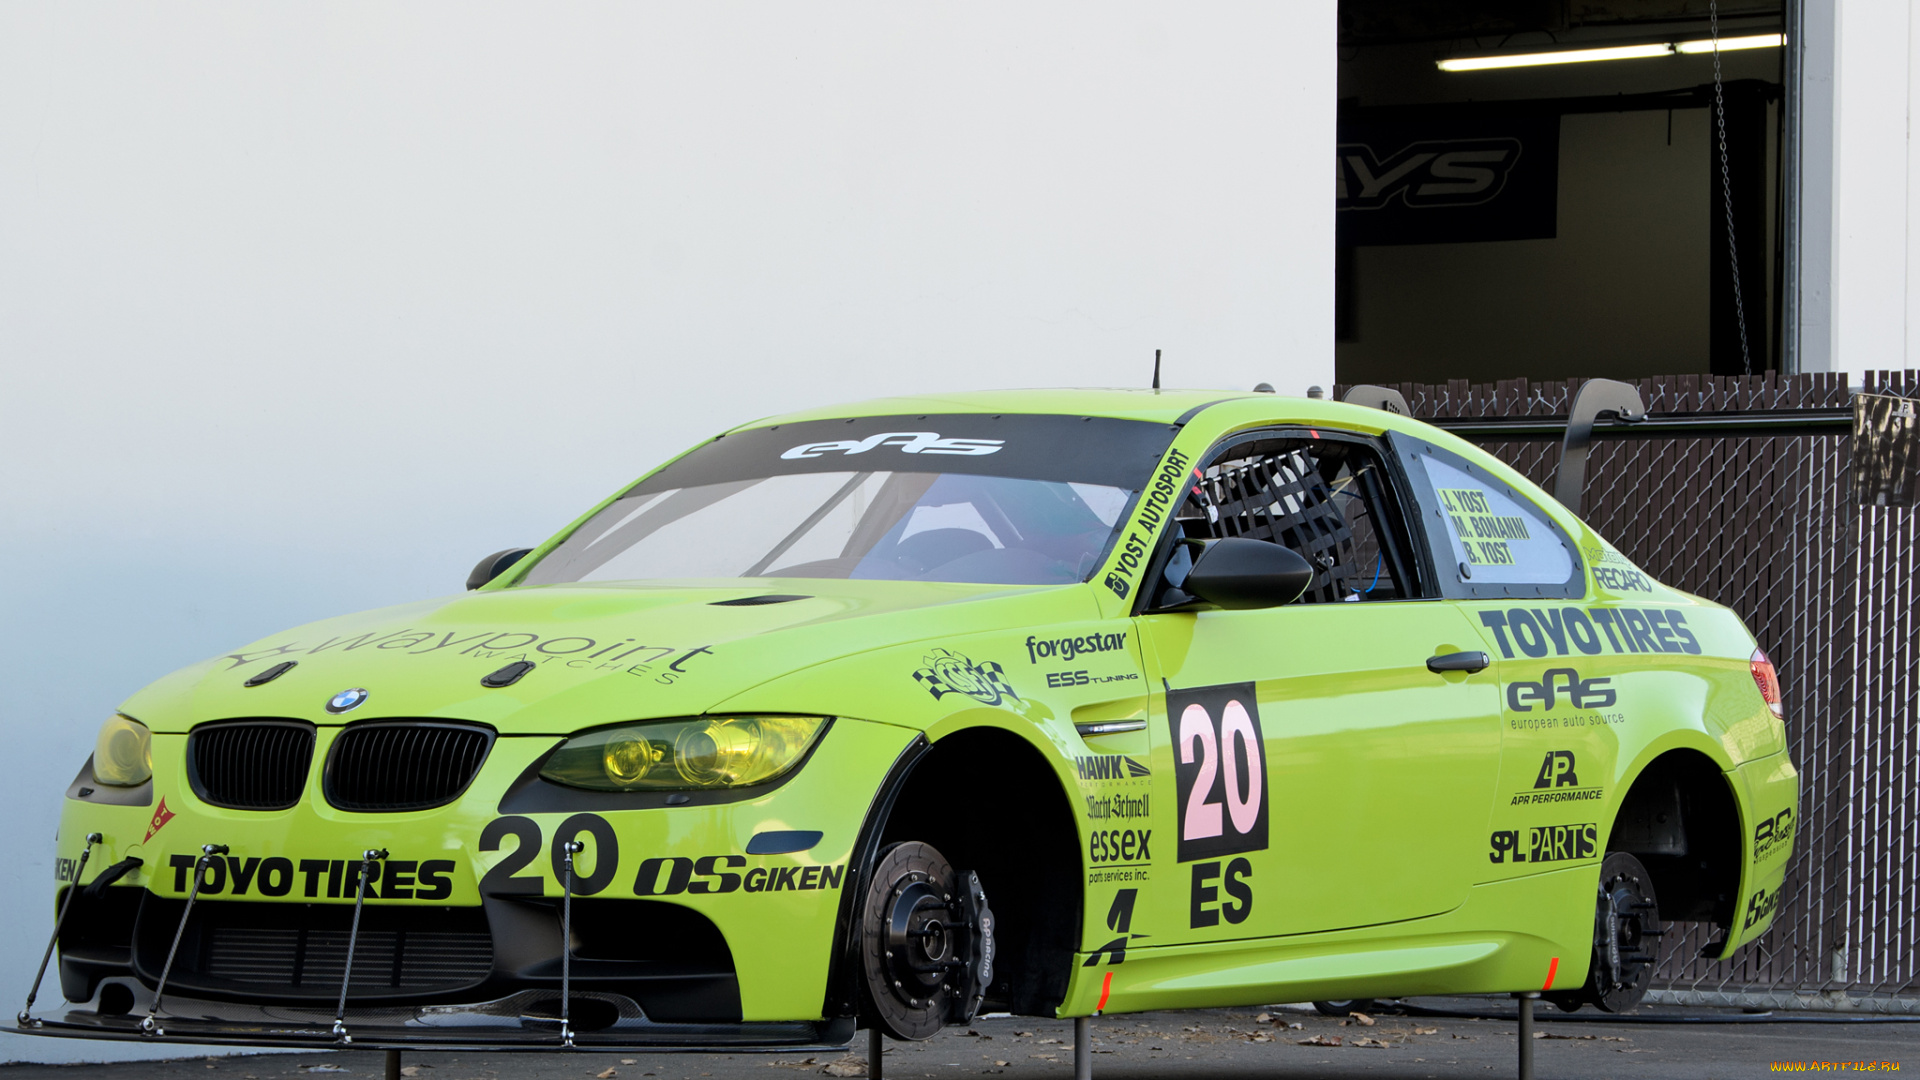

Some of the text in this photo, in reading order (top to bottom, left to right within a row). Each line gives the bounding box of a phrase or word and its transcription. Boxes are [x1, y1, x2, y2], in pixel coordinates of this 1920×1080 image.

[1337, 150, 1509, 198] YS
[1442, 490, 1490, 513] J. YOST
[1451, 515, 1531, 540] M. BONANNI
[1462, 541, 1514, 564] B. YOST
[1591, 567, 1652, 593] RECARO
[1026, 632, 1127, 664] forgestar
[1478, 607, 1702, 659] TOYO TIRES
[306, 629, 714, 673] Waypoint
[473, 650, 679, 686] WATCHES
[1511, 713, 1625, 732] european auto source
[1075, 755, 1124, 780] HAWK
[1179, 699, 1262, 841] 20
[1111, 793, 1149, 823] Schnell
[1511, 790, 1603, 806] APR PERFORMANCE
[477, 812, 619, 897] 20
[1090, 829, 1152, 863] essex
[1489, 823, 1597, 864] SPL PARTS
[169, 854, 456, 899] TOYO TIRES
[1104, 869, 1133, 882] services
[1135, 868, 1150, 881] inc.
[1190, 857, 1253, 929] ES
